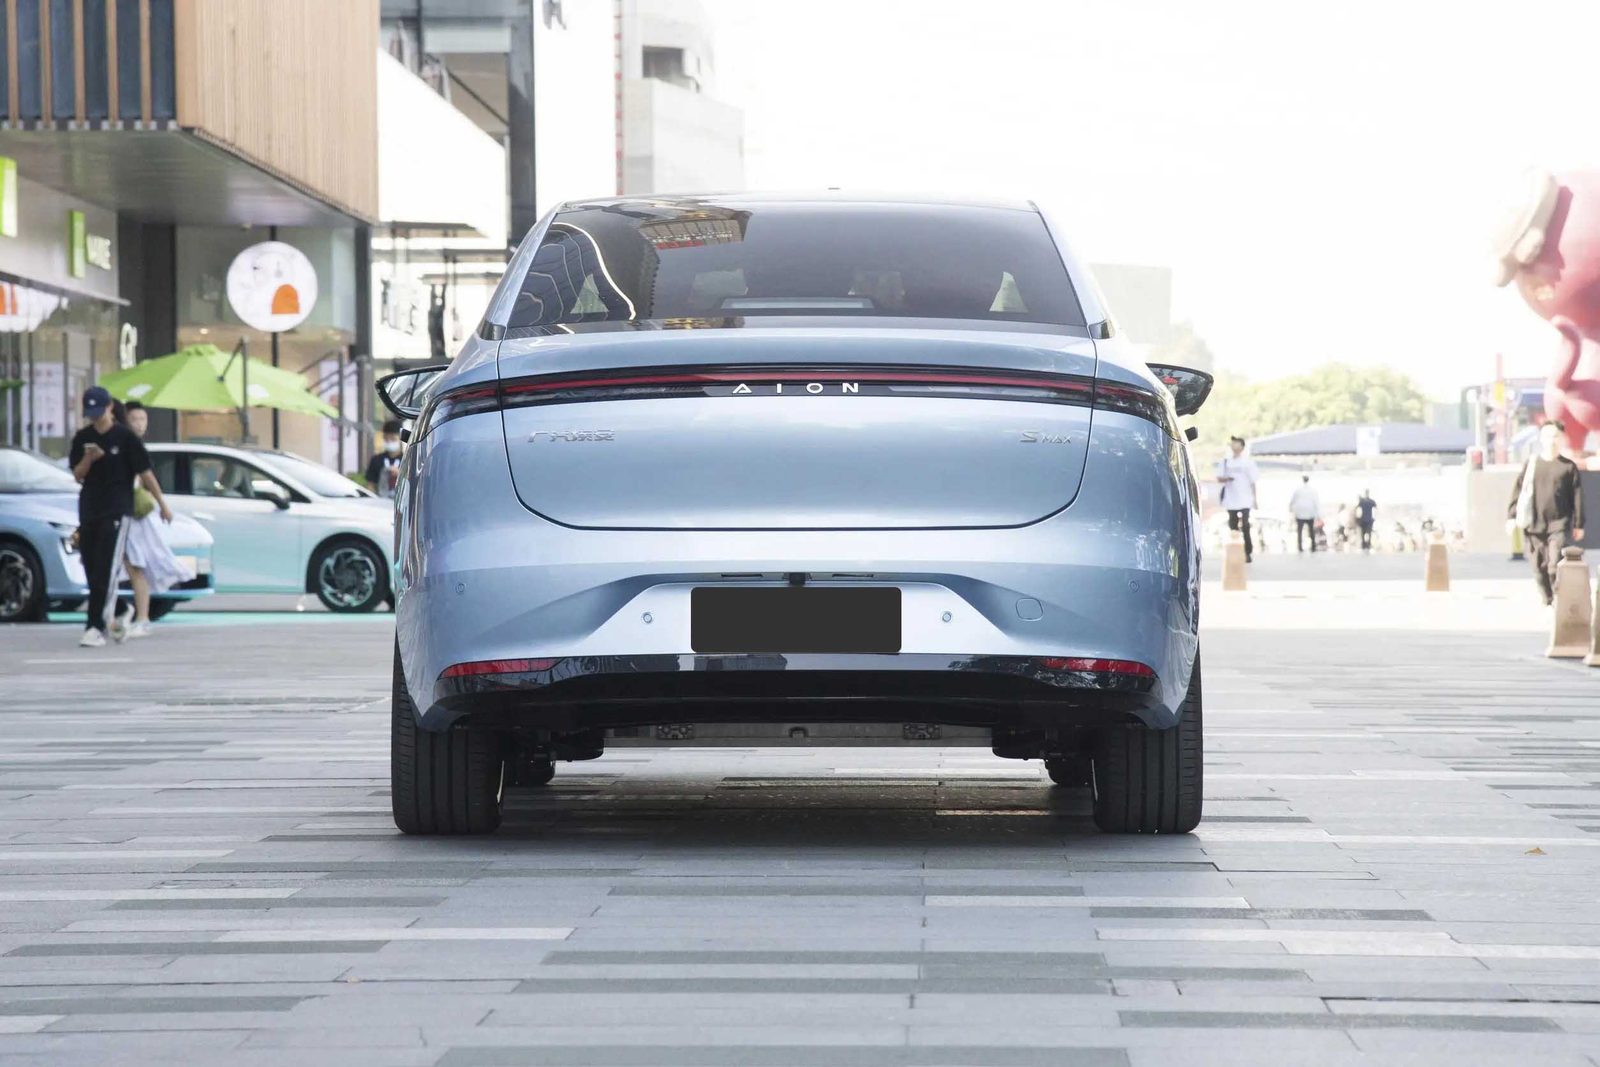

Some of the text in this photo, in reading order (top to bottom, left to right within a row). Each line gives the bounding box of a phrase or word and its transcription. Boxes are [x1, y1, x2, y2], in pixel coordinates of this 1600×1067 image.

[732, 382, 859, 394] AION
[1020, 430, 1071, 444] S MAX
